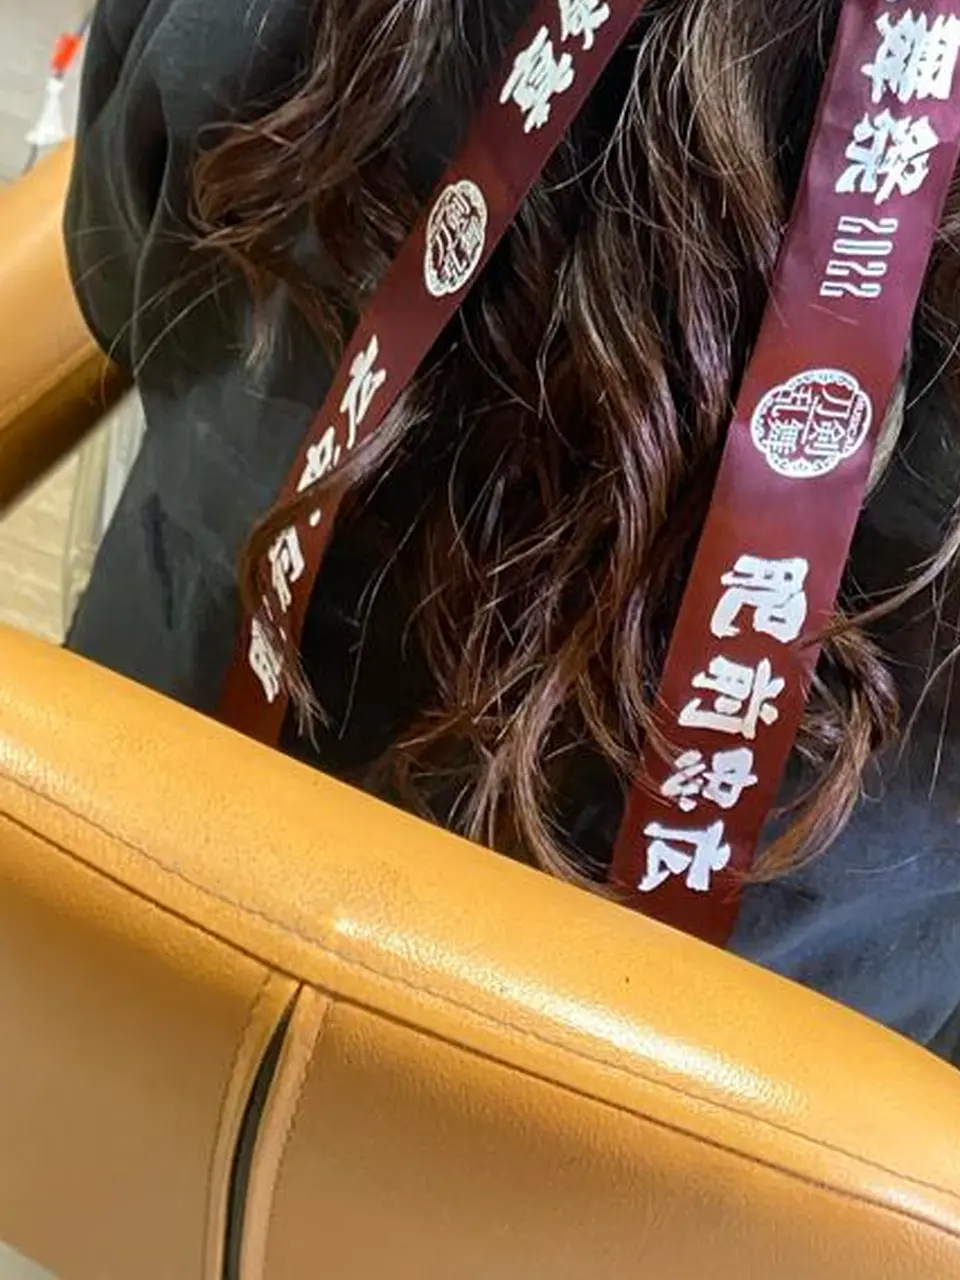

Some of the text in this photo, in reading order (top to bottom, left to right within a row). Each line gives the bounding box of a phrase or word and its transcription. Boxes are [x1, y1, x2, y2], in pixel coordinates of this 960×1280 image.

[820, 215, 898, 298] 2022
[638, 554, 809, 892] 肥前忠広
